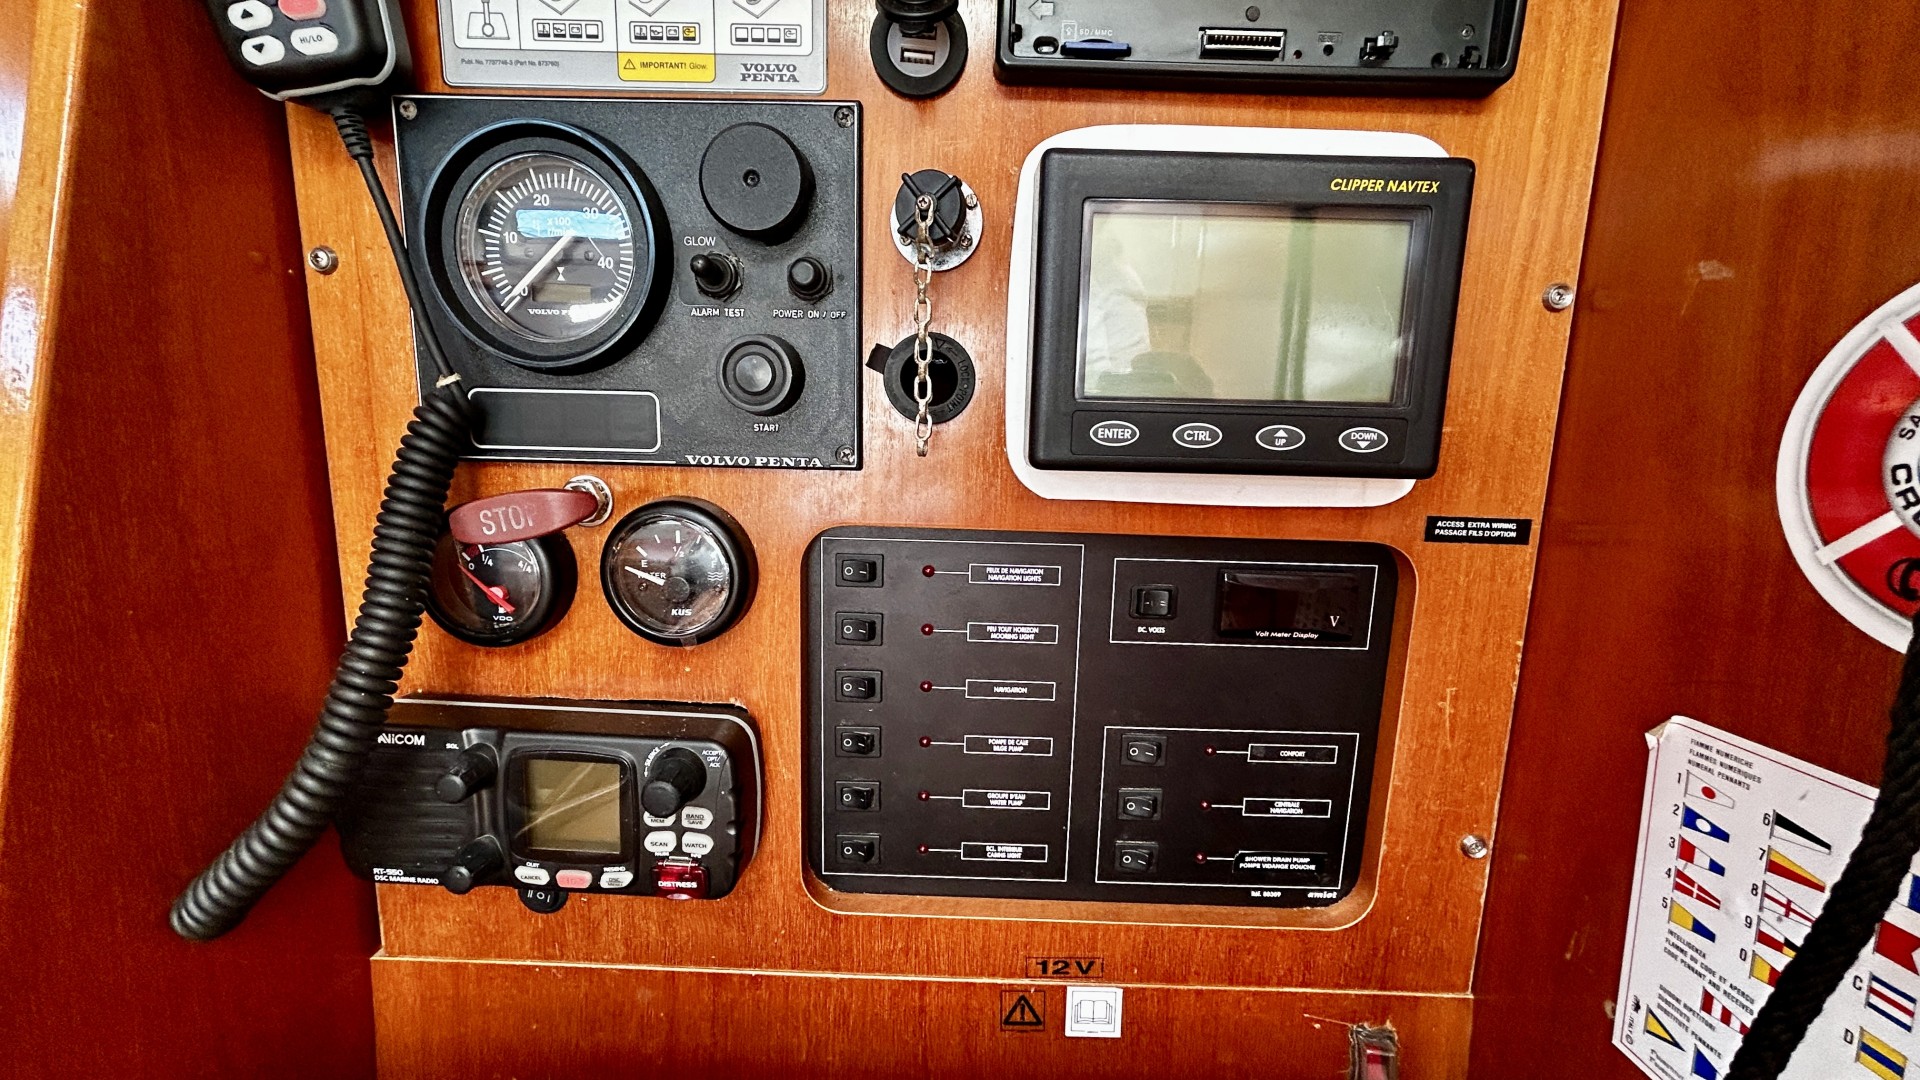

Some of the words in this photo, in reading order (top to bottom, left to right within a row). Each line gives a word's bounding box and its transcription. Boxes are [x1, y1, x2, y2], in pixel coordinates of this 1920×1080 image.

[1079, 28, 1113, 37] SD/MMC
[299, 34, 323, 44] HI/LO
[639, 61, 687, 69] IMPORTANT!
[740, 63, 798, 73] VOLVO
[740, 73, 800, 83] PENTA
[1330, 177, 1384, 193] CLIPPER
[1386, 179, 1440, 194] NAVTEX
[533, 194, 550, 207] 20
[582, 207, 599, 219] 30
[503, 232, 518, 244] 10
[683, 236, 716, 247] GLOW
[597, 257, 614, 269] 40
[691, 308, 719, 317] ALARM
[725, 308, 745, 317] TEST
[773, 309, 804, 318] POWER
[808, 310, 820, 319] ON
[830, 311, 847, 319] OFF
[753, 423, 779, 432] START
[1097, 428, 1132, 439] ENTER
[1183, 430, 1212, 441] CTRL
[1351, 432, 1378, 441] DOWN
[1275, 438, 1287, 446] UP
[685, 455, 750, 467] VOLVO
[755, 456, 824, 467] PENTA
[479, 503, 537, 535] STOP
[1436, 520, 1465, 528] ACCESS
[1491, 522, 1517, 530] WIRING
[1484, 530, 1517, 538] D'OPTION
[518, 560, 532, 573] 4/4
[641, 560, 648, 568] E
[1009, 567, 1044, 575] NAVIGATION
[987, 574, 1022, 582] NAVIGATION
[671, 608, 692, 616] KUS
[1330, 615, 1340, 627] V
[1293, 631, 1319, 640] Display
[1677, 772, 1682, 784] 1
[1672, 803, 1680, 816] 2
[1762, 813, 1771, 826] 6
[1669, 836, 1676, 849] 3
[1758, 847, 1766, 861] 7
[1665, 867, 1672, 879] 4
[658, 880, 698, 888] DISTRESS
[1750, 883, 1759, 897] 8
[1661, 896, 1668, 909] 5
[1744, 915, 1753, 929] 9
[1852, 974, 1863, 991] C
[1843, 1027, 1854, 1045] D
